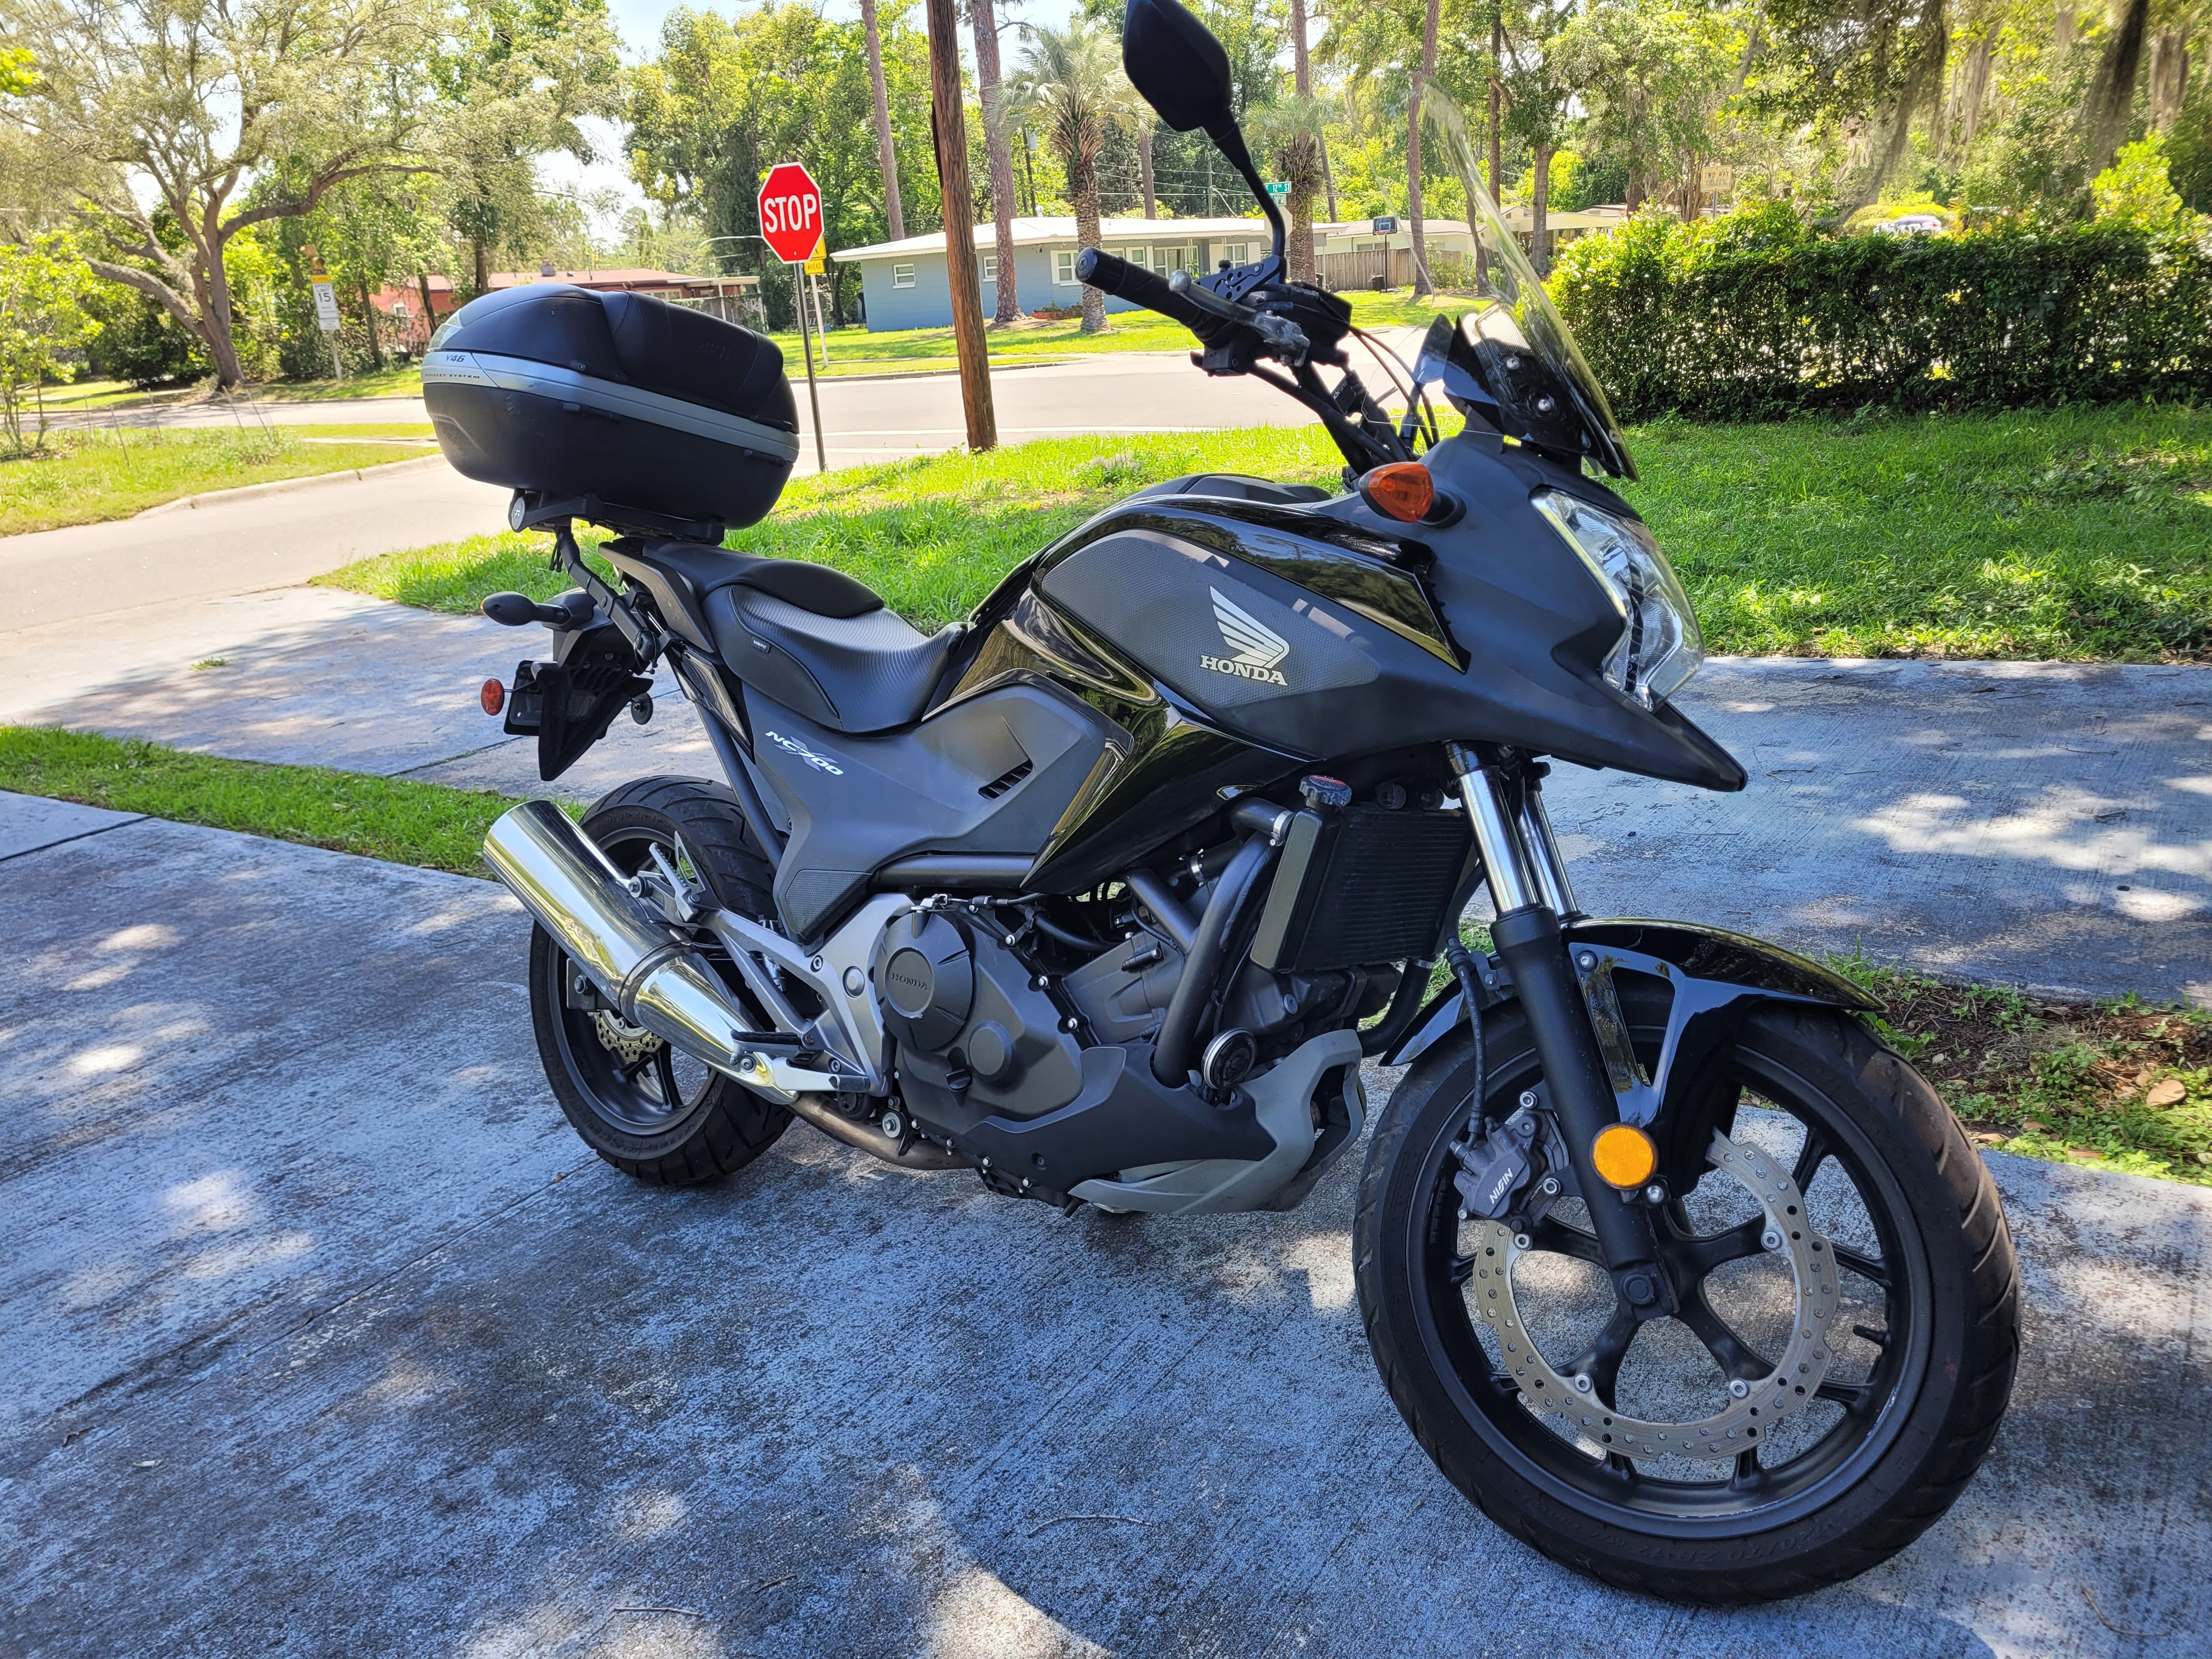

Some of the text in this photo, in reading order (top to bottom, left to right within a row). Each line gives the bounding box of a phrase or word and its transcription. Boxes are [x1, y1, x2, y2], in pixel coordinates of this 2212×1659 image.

[1284, 183, 1290, 191] ST
[764, 193, 817, 233] STOP
[318, 292, 331, 302] 15
[445, 354, 466, 363] V46
[1200, 654, 1288, 686] HONDA
[891, 972, 928, 990] HONDA
